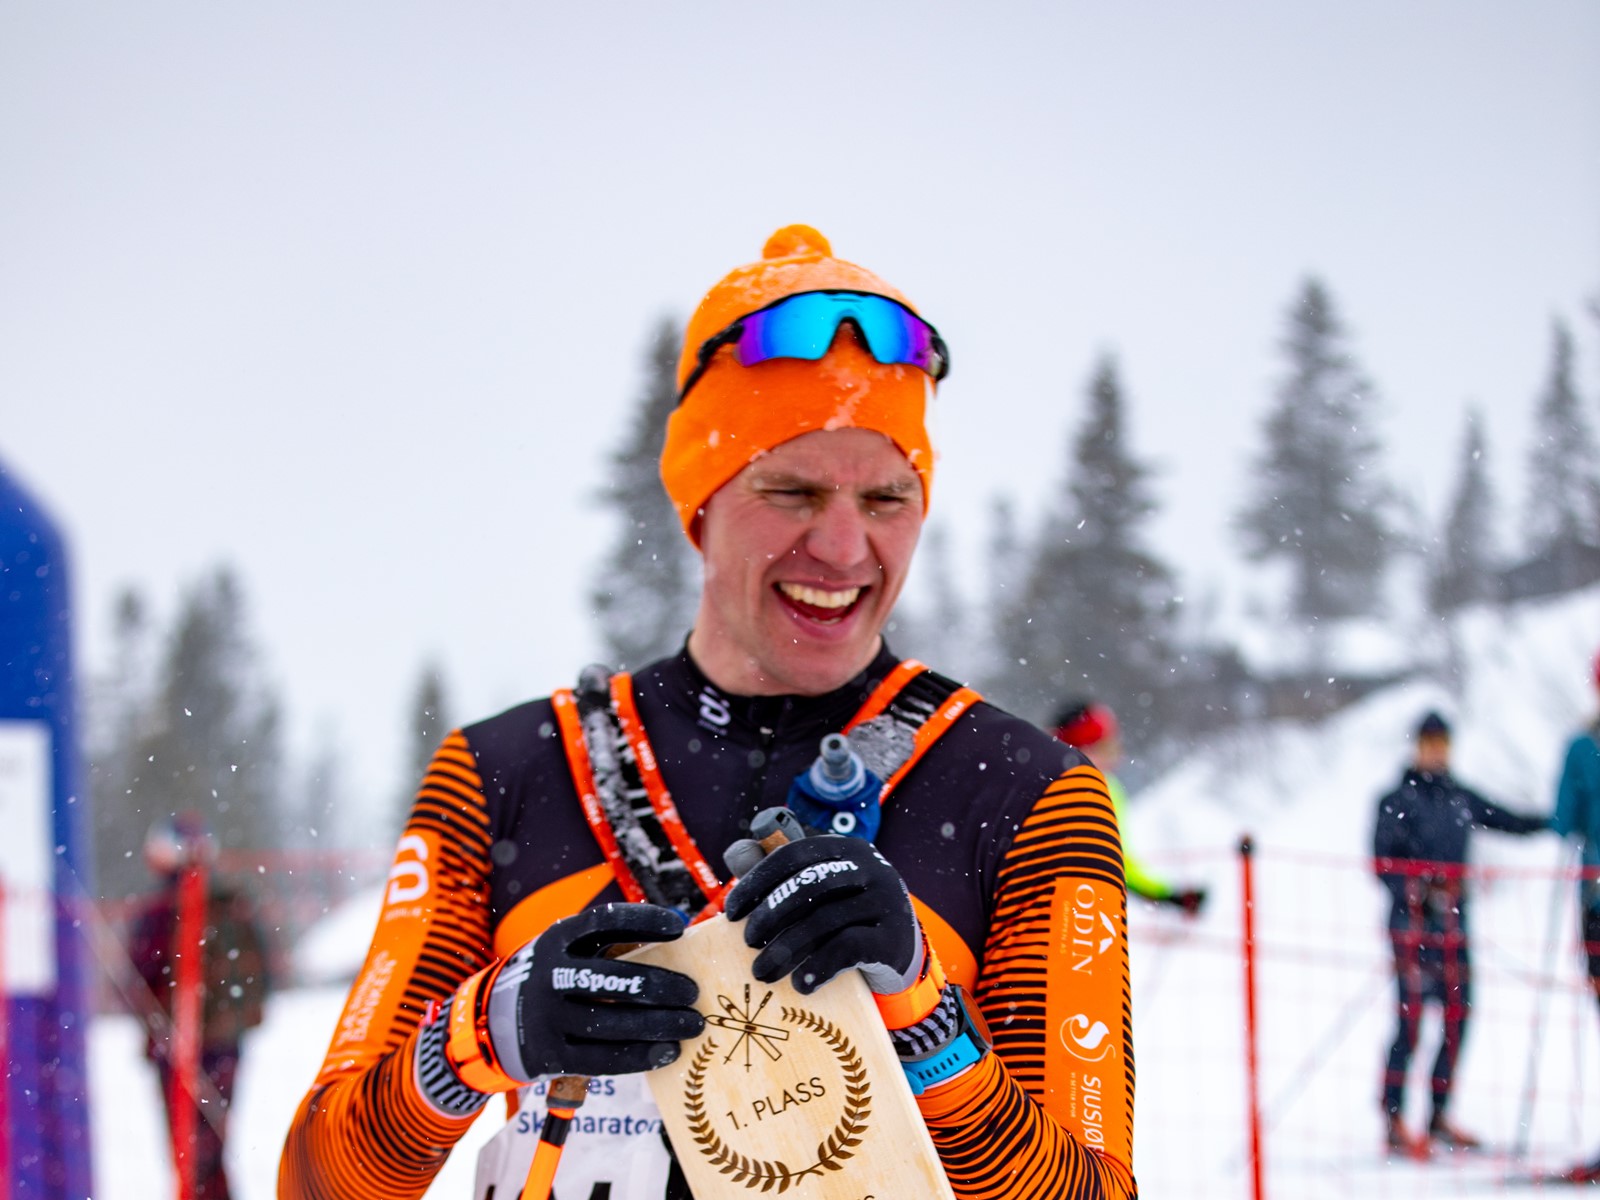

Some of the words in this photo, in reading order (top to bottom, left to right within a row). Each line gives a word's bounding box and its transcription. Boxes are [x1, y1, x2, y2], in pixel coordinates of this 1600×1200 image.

[1072, 883, 1095, 975] ODIN
[726, 1109, 749, 1131] 1.
[752, 1076, 827, 1121] PLASS
